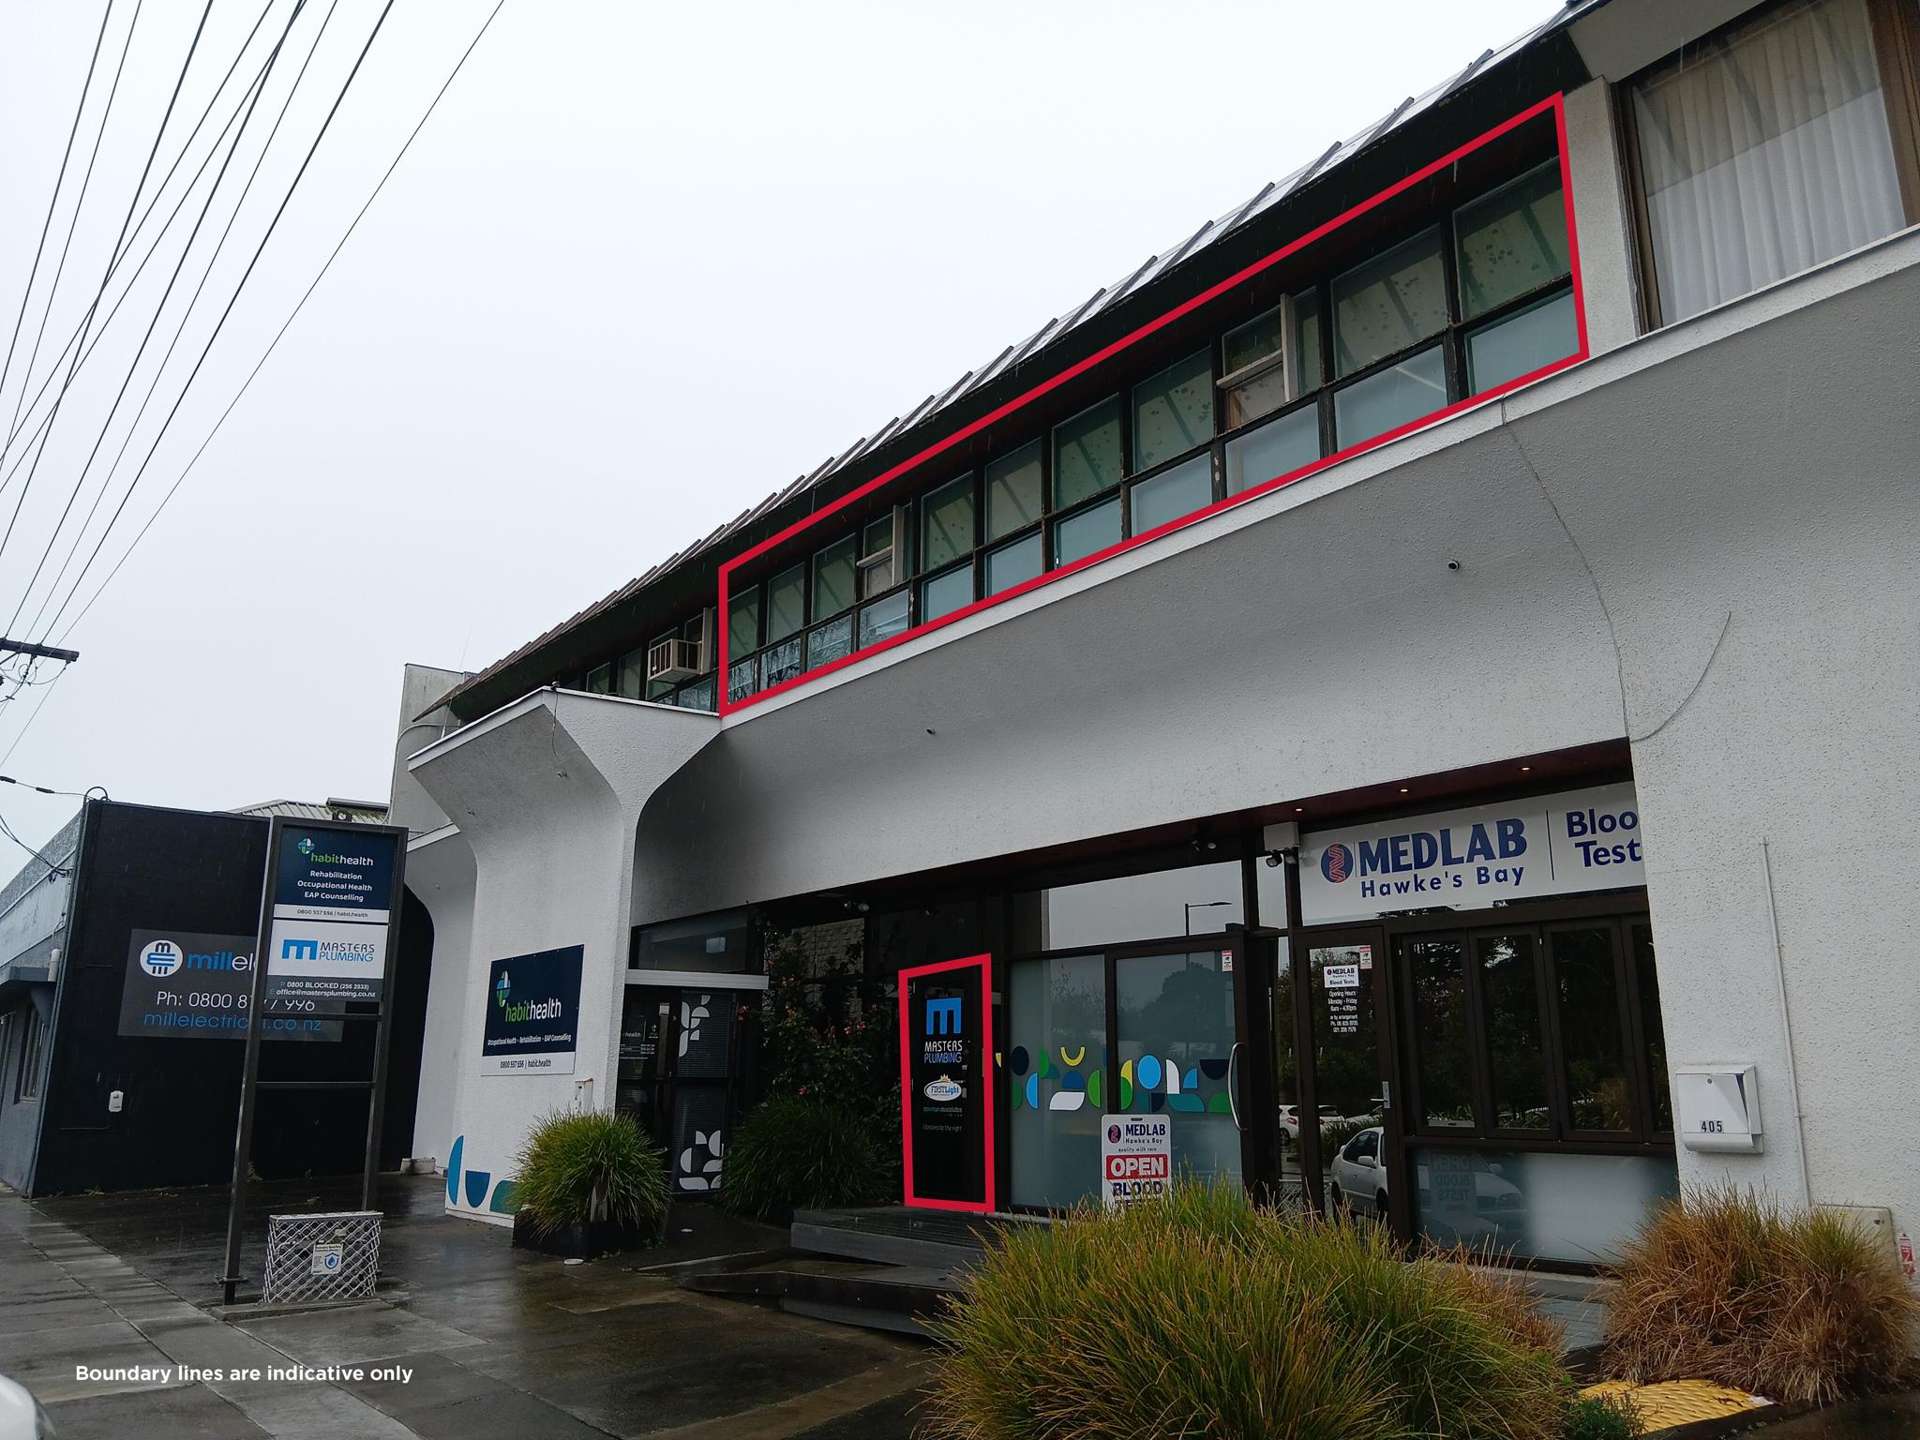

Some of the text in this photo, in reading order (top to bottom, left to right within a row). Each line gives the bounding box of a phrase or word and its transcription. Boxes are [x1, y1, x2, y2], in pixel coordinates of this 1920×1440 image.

[1566, 808, 1638, 838] Bloo
[1358, 818, 1528, 877] MEDLAB
[1574, 838, 1642, 867] Test
[310, 853, 374, 867] habithealth
[310, 870, 362, 880] Rehabilitation
[1361, 865, 1525, 898] Hawke's Bay
[297, 880, 373, 892] Occupational Health
[320, 892, 364, 902] Counselling
[320, 942, 375, 953] MASTERS
[186, 951, 256, 972] millel
[319, 952, 374, 962] PLUMBING
[156, 991, 182, 1007] Ph:
[188, 992, 232, 1008] 0800
[505, 996, 562, 1024] habithealth
[924, 1040, 963, 1053] MASTERS
[924, 1052, 962, 1064] PLUMBING
[1125, 1124, 1166, 1137] MEDLAB
[1701, 1120, 1723, 1132] 405
[1110, 1157, 1164, 1177] OPEN
[1113, 1181, 1164, 1196] BLOOD
